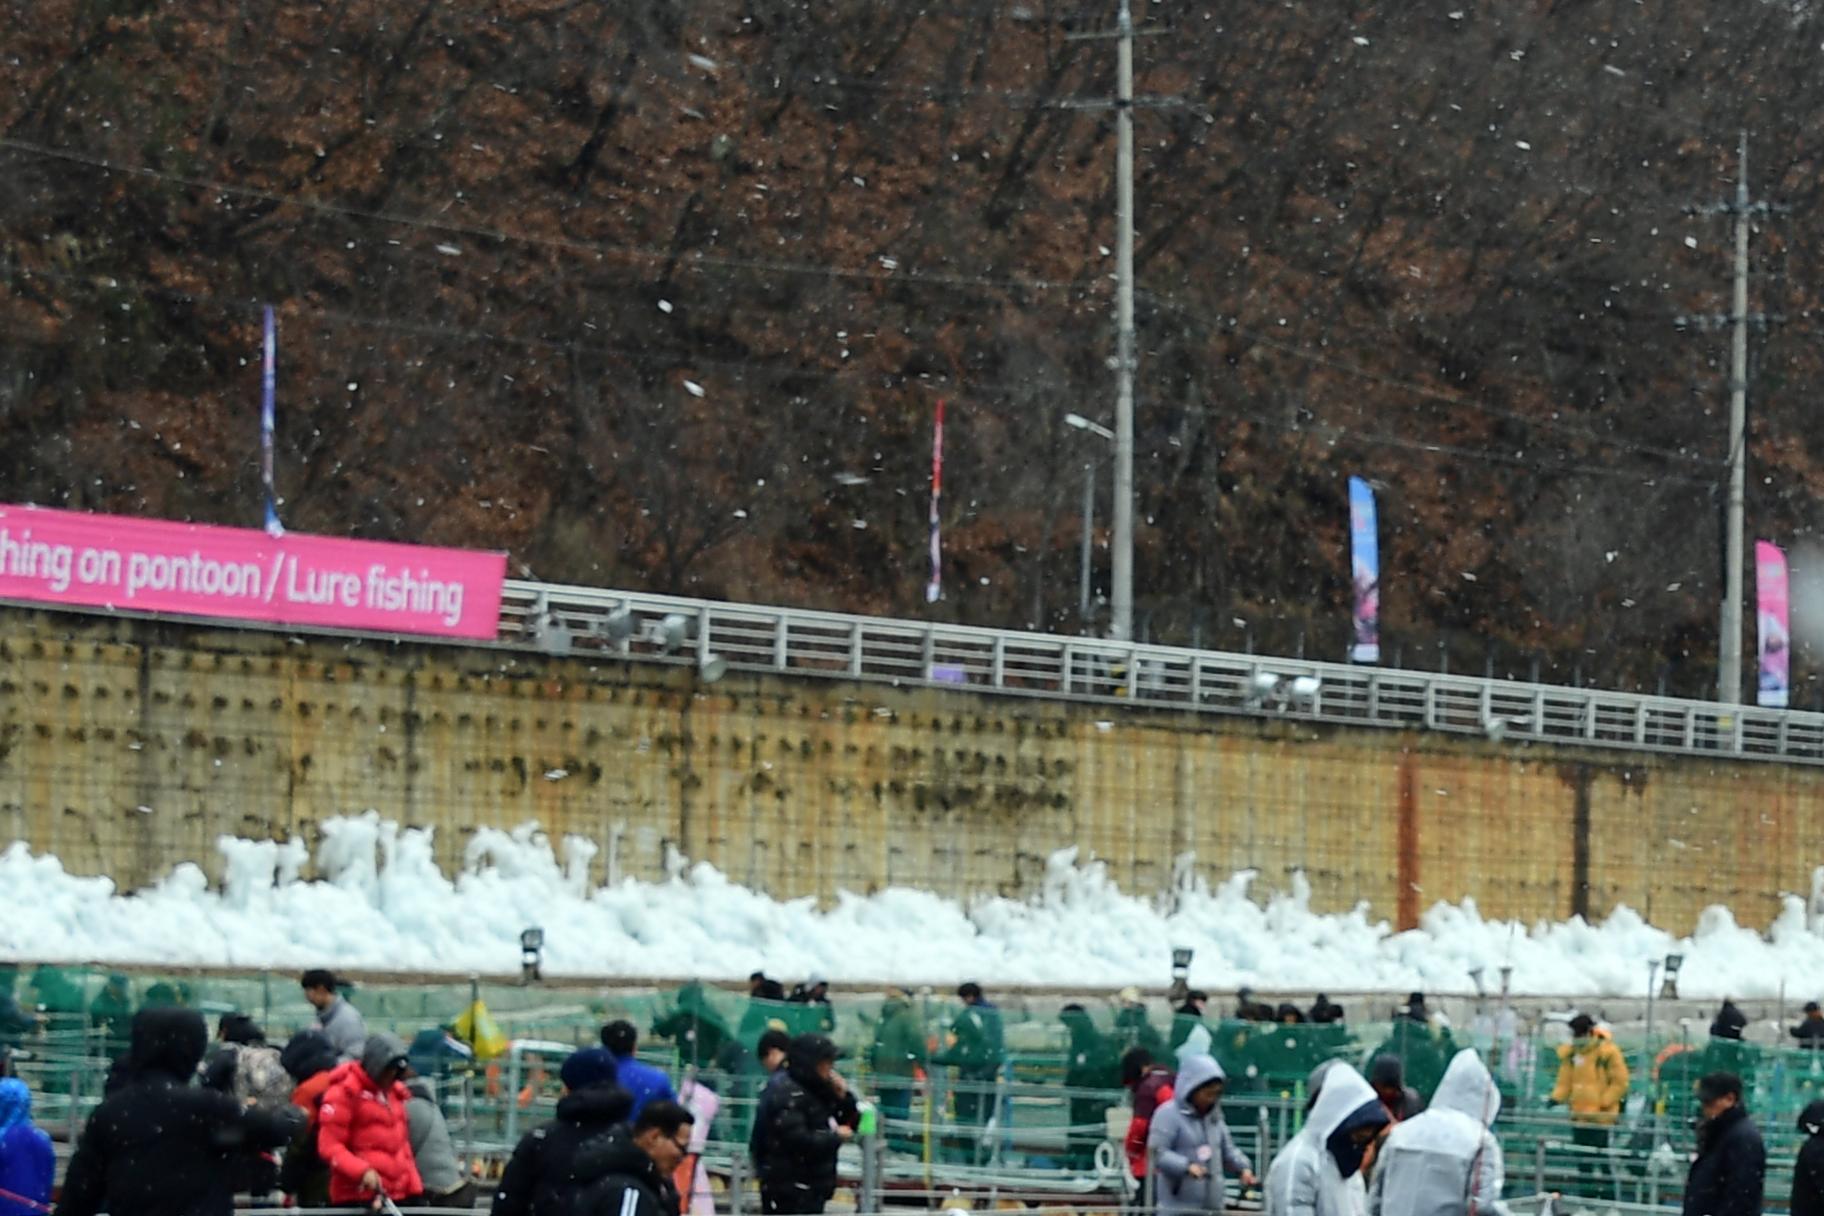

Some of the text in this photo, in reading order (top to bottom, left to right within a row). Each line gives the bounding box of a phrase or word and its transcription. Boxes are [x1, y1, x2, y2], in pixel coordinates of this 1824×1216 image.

[78, 547, 121, 585] on
[126, 550, 262, 598] pontoon
[286, 555, 361, 607] Lure
[366, 564, 464, 627] fishing
